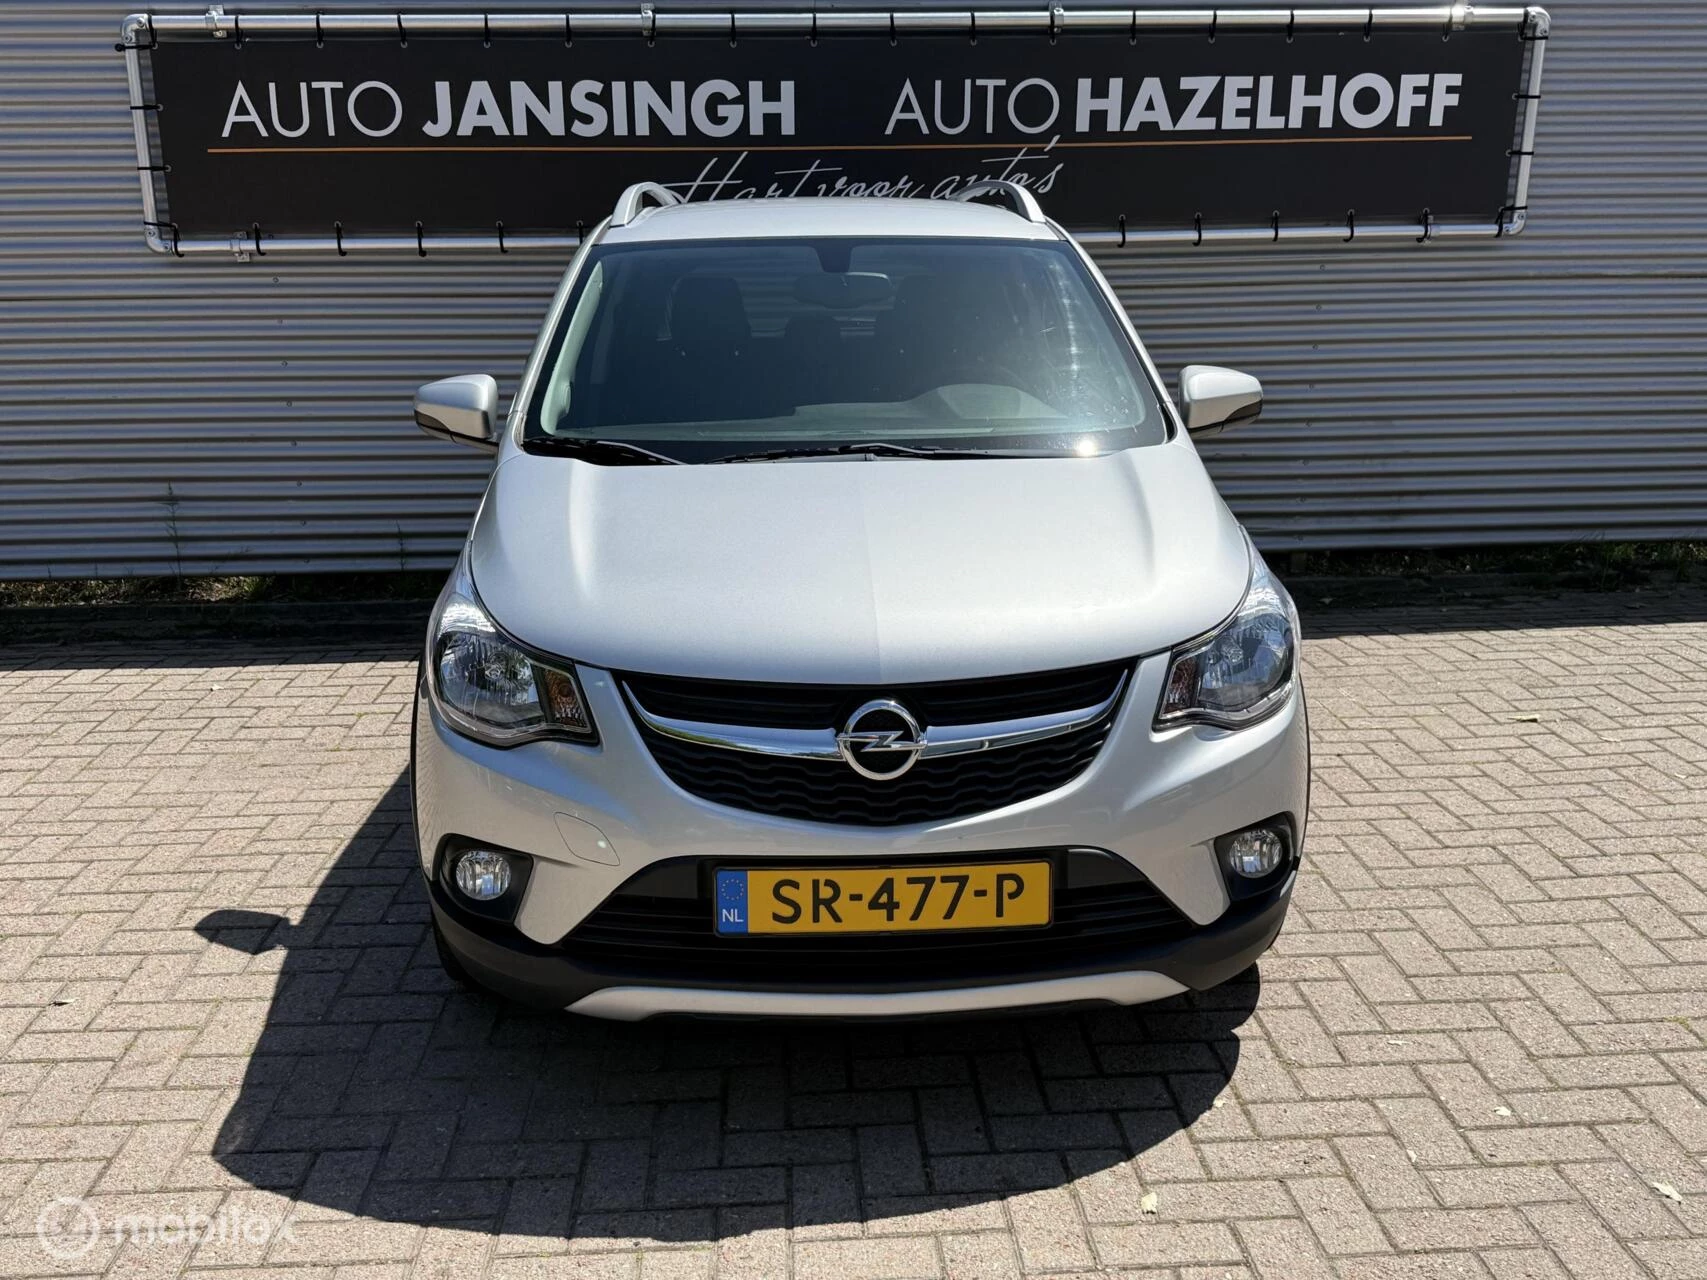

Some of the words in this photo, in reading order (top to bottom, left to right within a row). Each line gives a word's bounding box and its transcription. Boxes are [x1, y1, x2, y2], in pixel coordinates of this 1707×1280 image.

[221, 80, 403, 138] AUTO
[422, 79, 796, 137] JANSINGH
[884, 77, 1060, 135] AUTO
[1075, 73, 1463, 132] HAZELHOFF
[721, 908, 744, 923] NL
[772, 873, 1025, 925] SR-477-P
